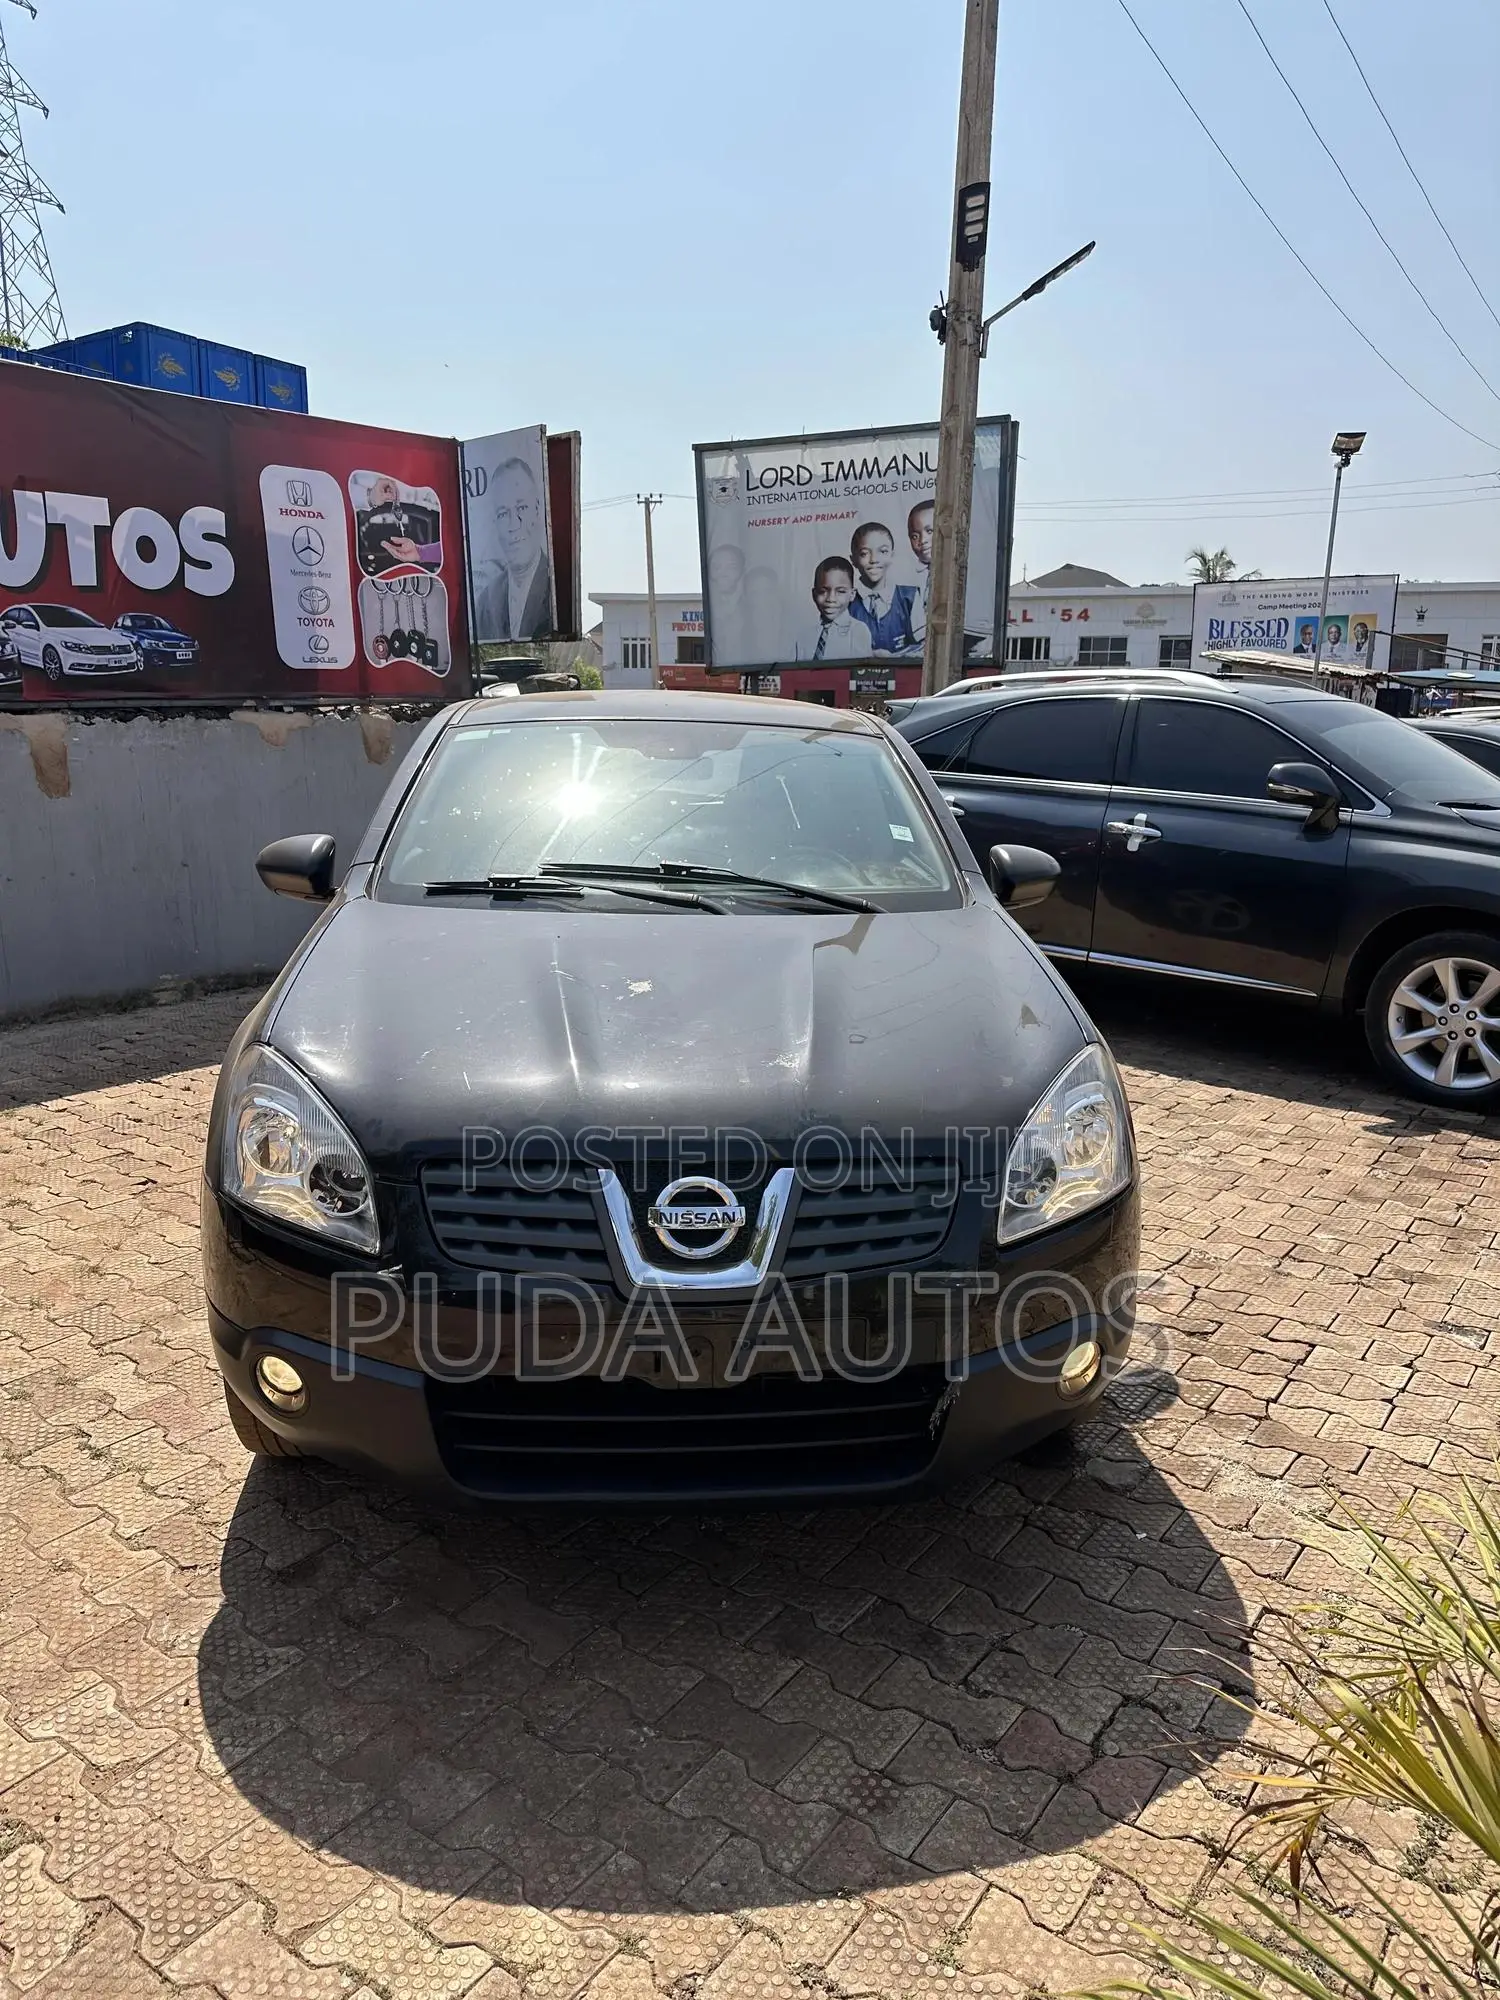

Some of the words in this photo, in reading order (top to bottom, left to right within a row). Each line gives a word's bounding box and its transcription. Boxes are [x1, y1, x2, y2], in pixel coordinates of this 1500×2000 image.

[746, 463, 813, 492] LORD
[746, 487, 841, 506] INTERNATIONAL
[843, 480, 899, 497] SCHOOLS
[278, 508, 326, 519] HONDA
[748, 515, 790, 528] NURSERY
[791, 513, 813, 524] AND
[815, 510, 859, 522] PRIMARY
[290, 568, 332, 579] Mercedes-Benz
[1328, 589, 1370, 597] INISTRIES
[1257, 603, 1279, 611] Camp
[1279, 602, 1306, 611] Meeting
[297, 617, 335, 628] TOYOTA
[672, 622, 696, 632] PHOTO
[1208, 616, 1290, 641] BLESSED
[1240, 638, 1288, 650] FAVOURED
[302, 656, 338, 664] LEXUS
[660, 1212, 735, 1224] NISSAN
